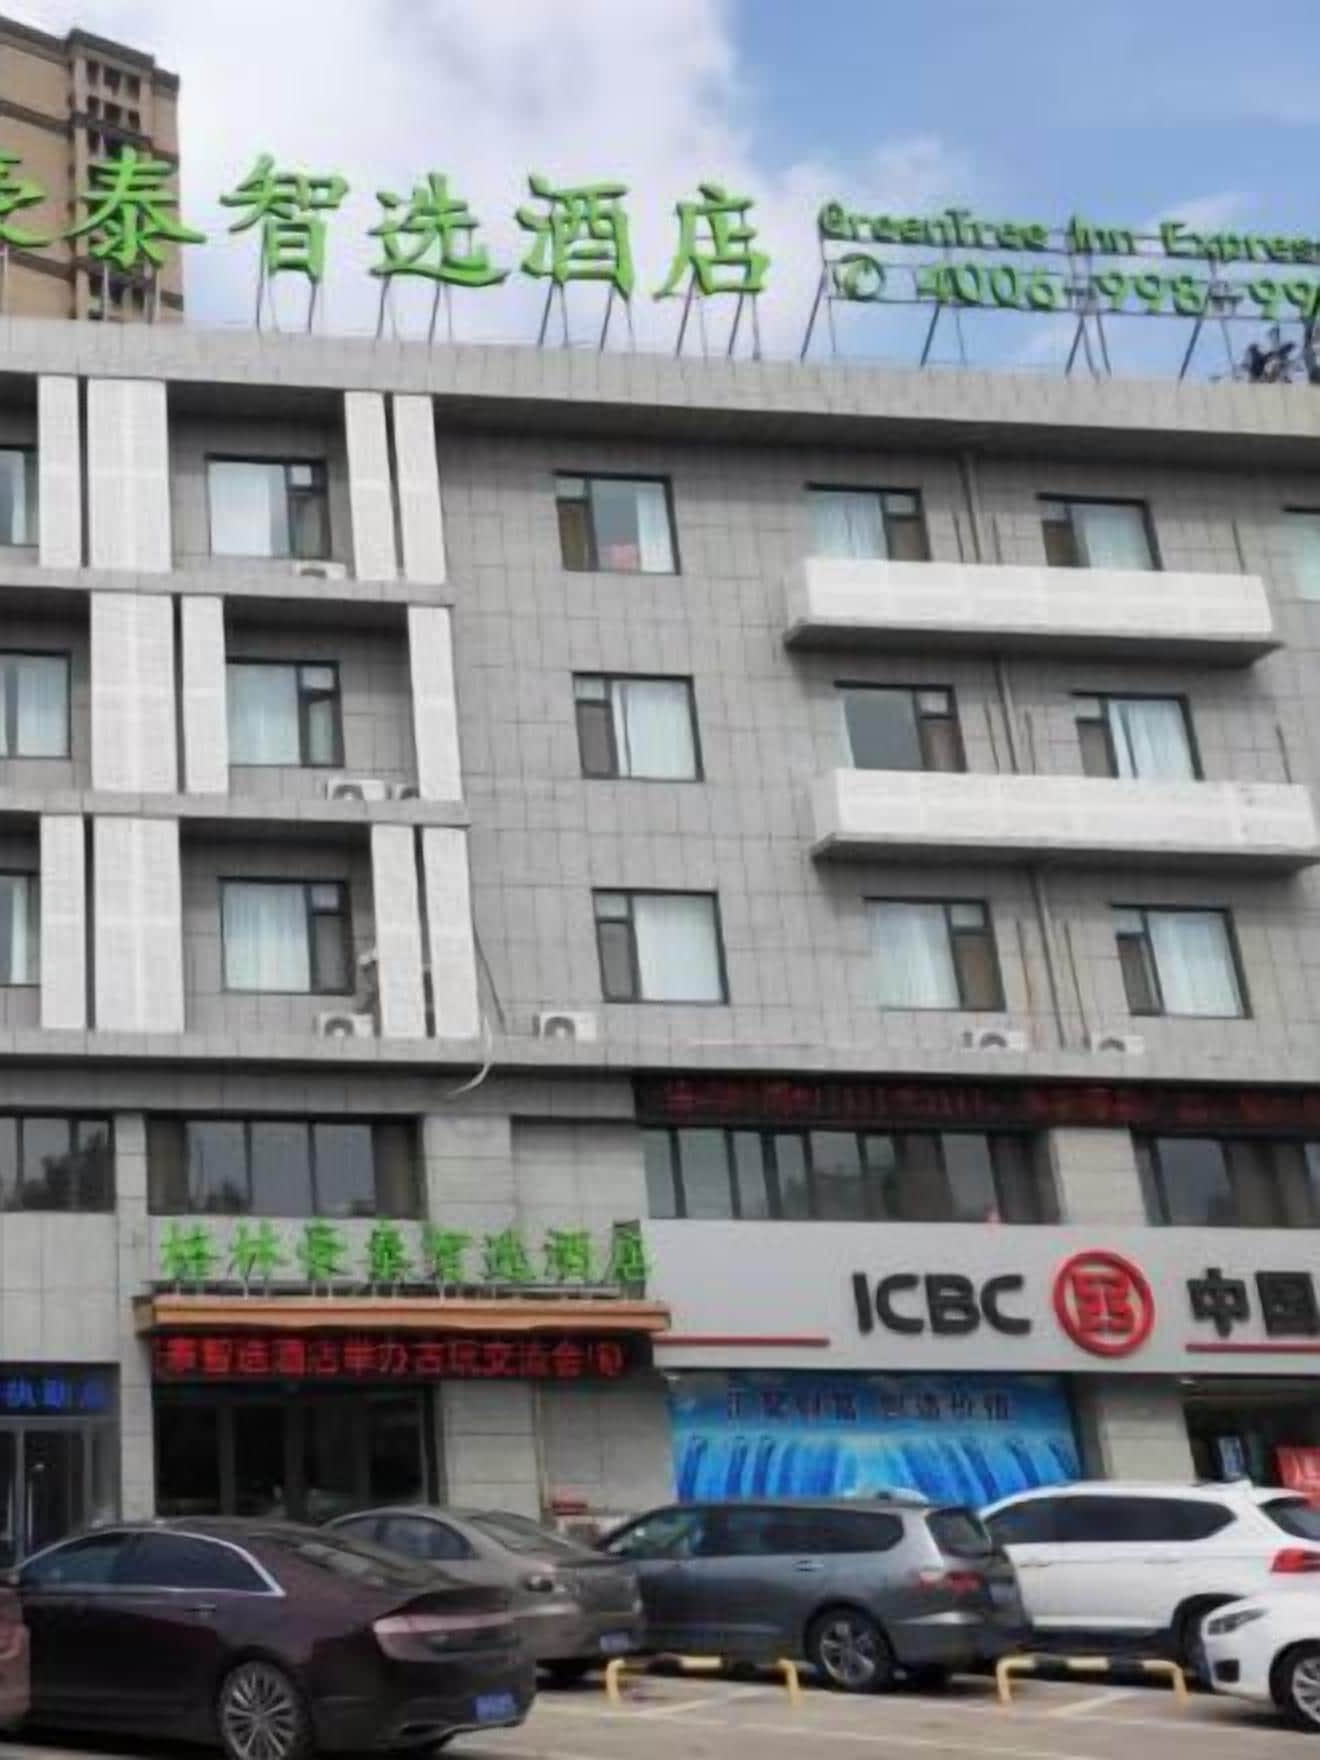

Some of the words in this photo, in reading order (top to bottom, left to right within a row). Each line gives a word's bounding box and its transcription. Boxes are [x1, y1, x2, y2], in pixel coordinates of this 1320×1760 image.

[818, 202, 1048, 250] GreenTree
[1160, 222, 1320, 264] Expres
[851, 1273, 1032, 1337] ICBC
[1185, 1267, 1320, 1338] 中国
